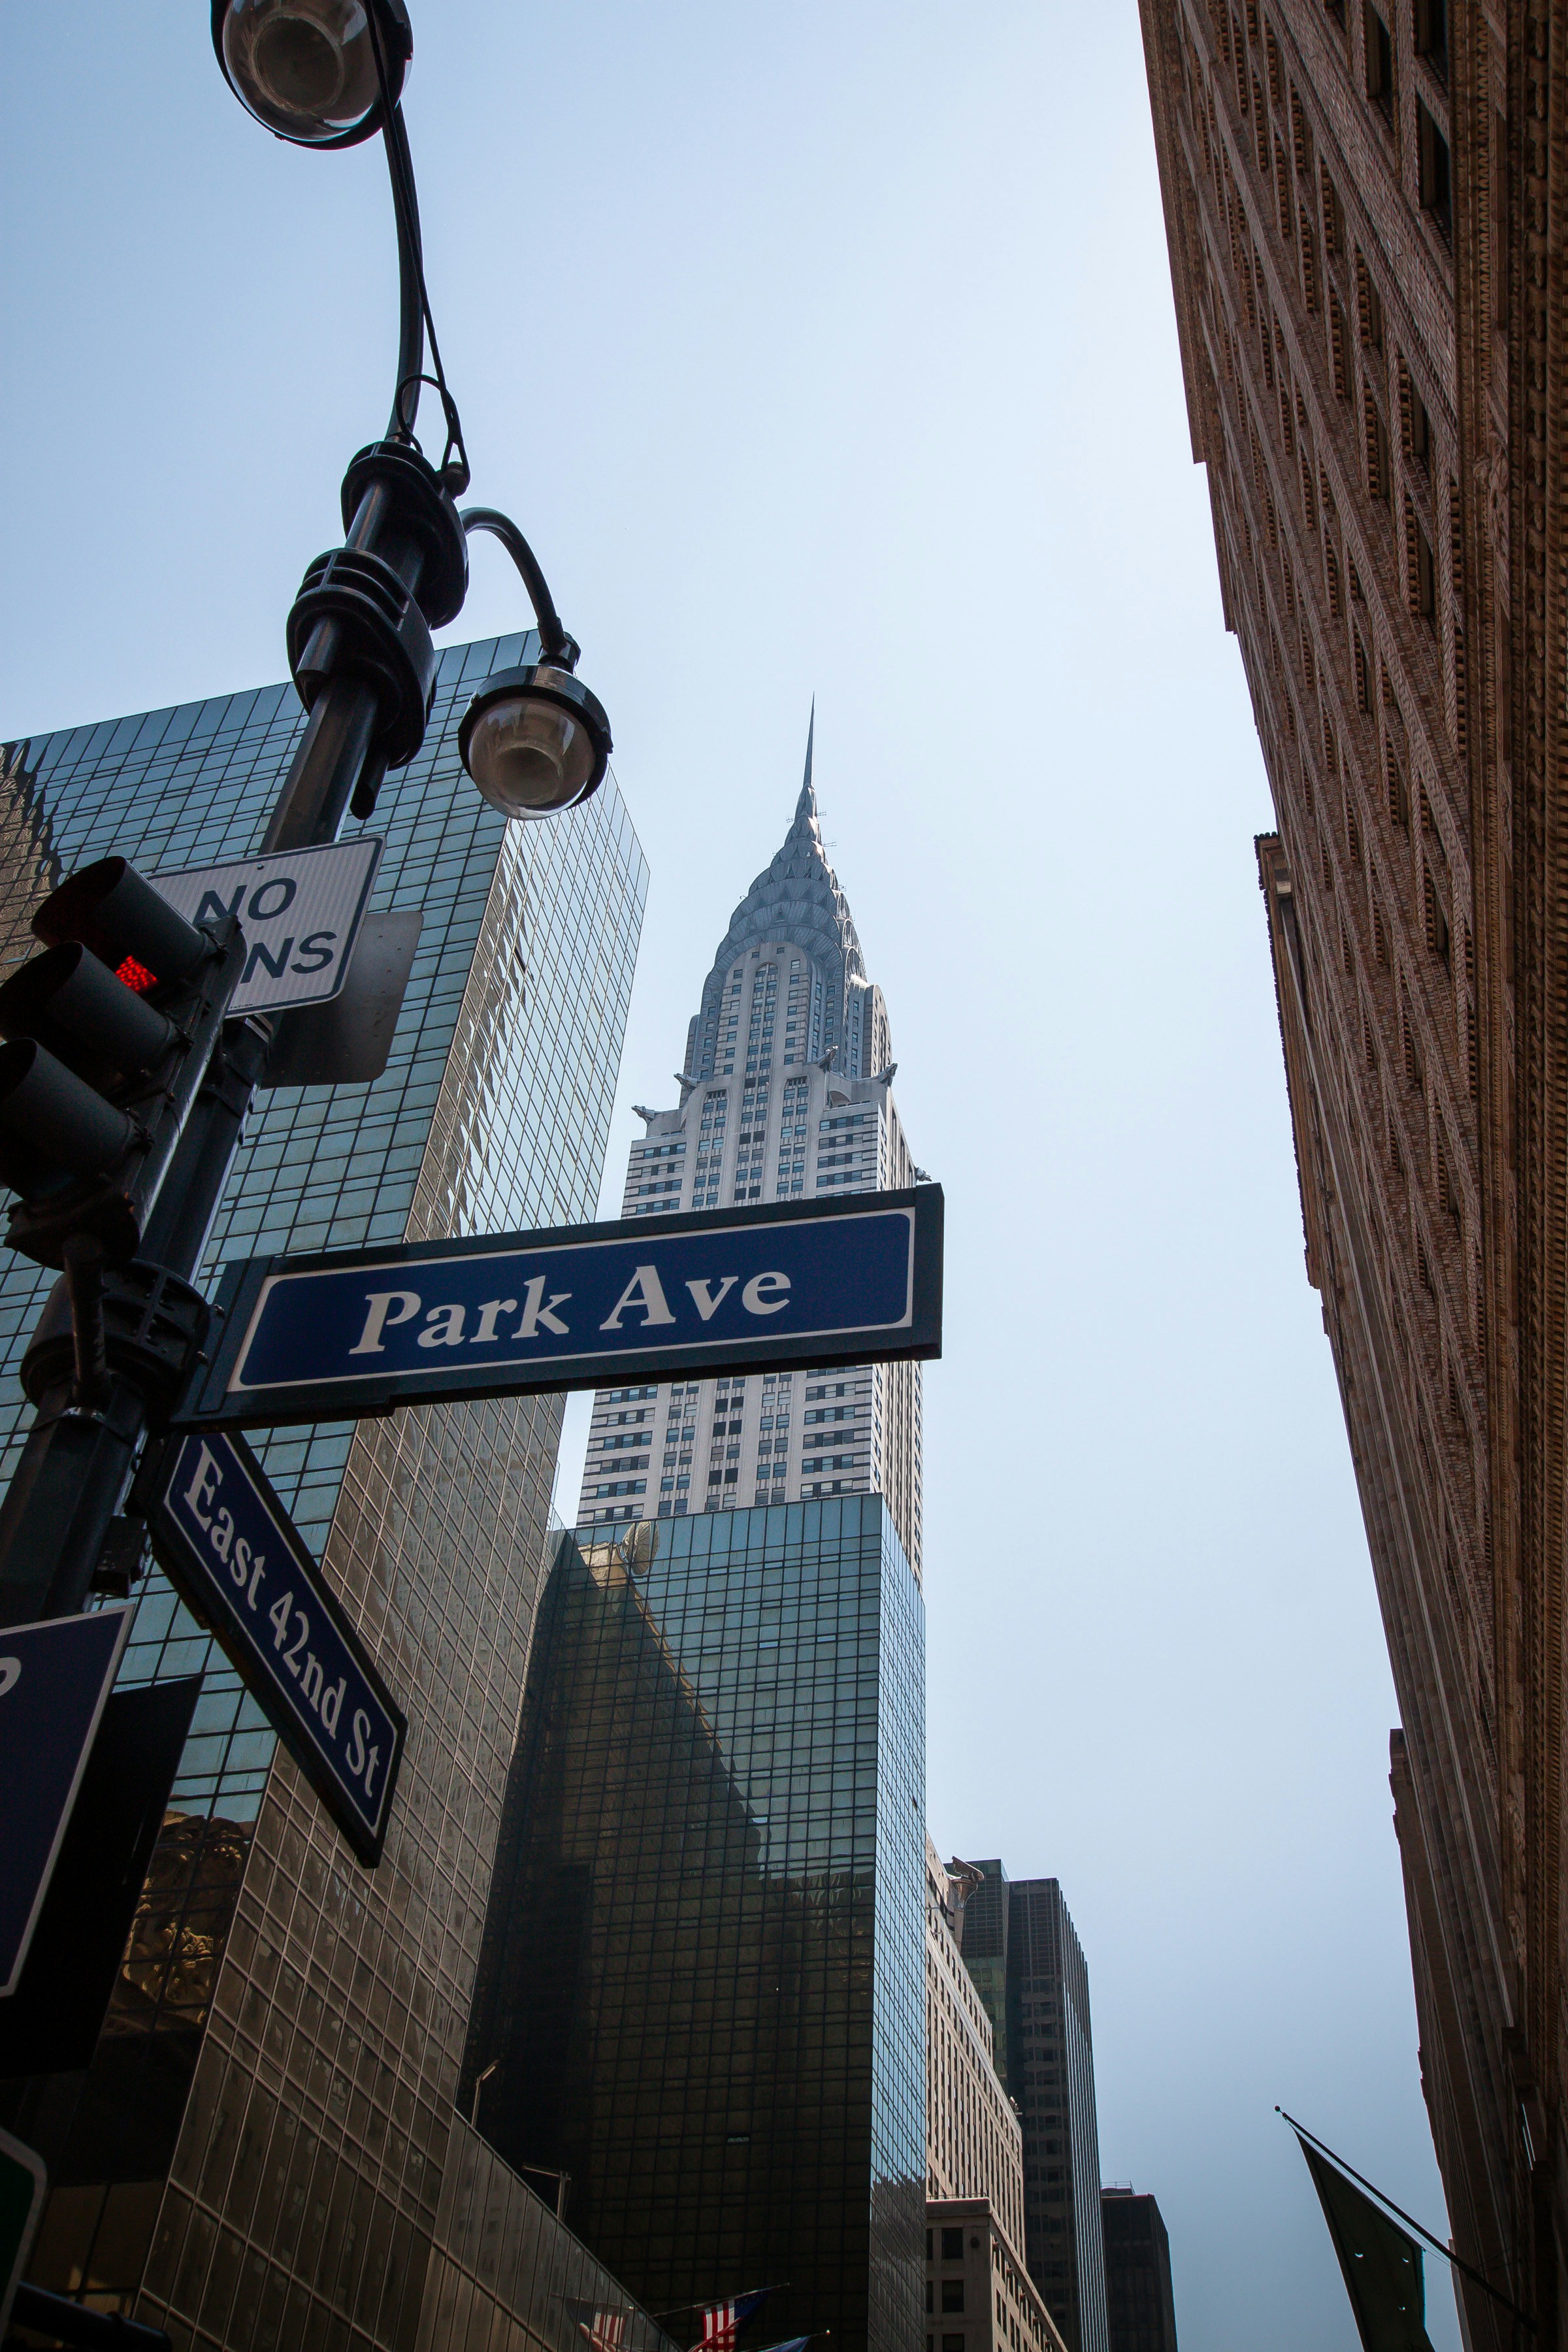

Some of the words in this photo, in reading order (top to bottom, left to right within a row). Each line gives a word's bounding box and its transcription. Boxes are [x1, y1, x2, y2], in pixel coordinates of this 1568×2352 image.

[192, 877, 297, 925] NO
[240, 931, 338, 984] NS
[348, 1275, 572, 1355] Park
[599, 1265, 791, 1330] Ave
[184, 1439, 266, 1612] East
[269, 1590, 348, 1740] 42nd
[345, 1708, 380, 1798] St
